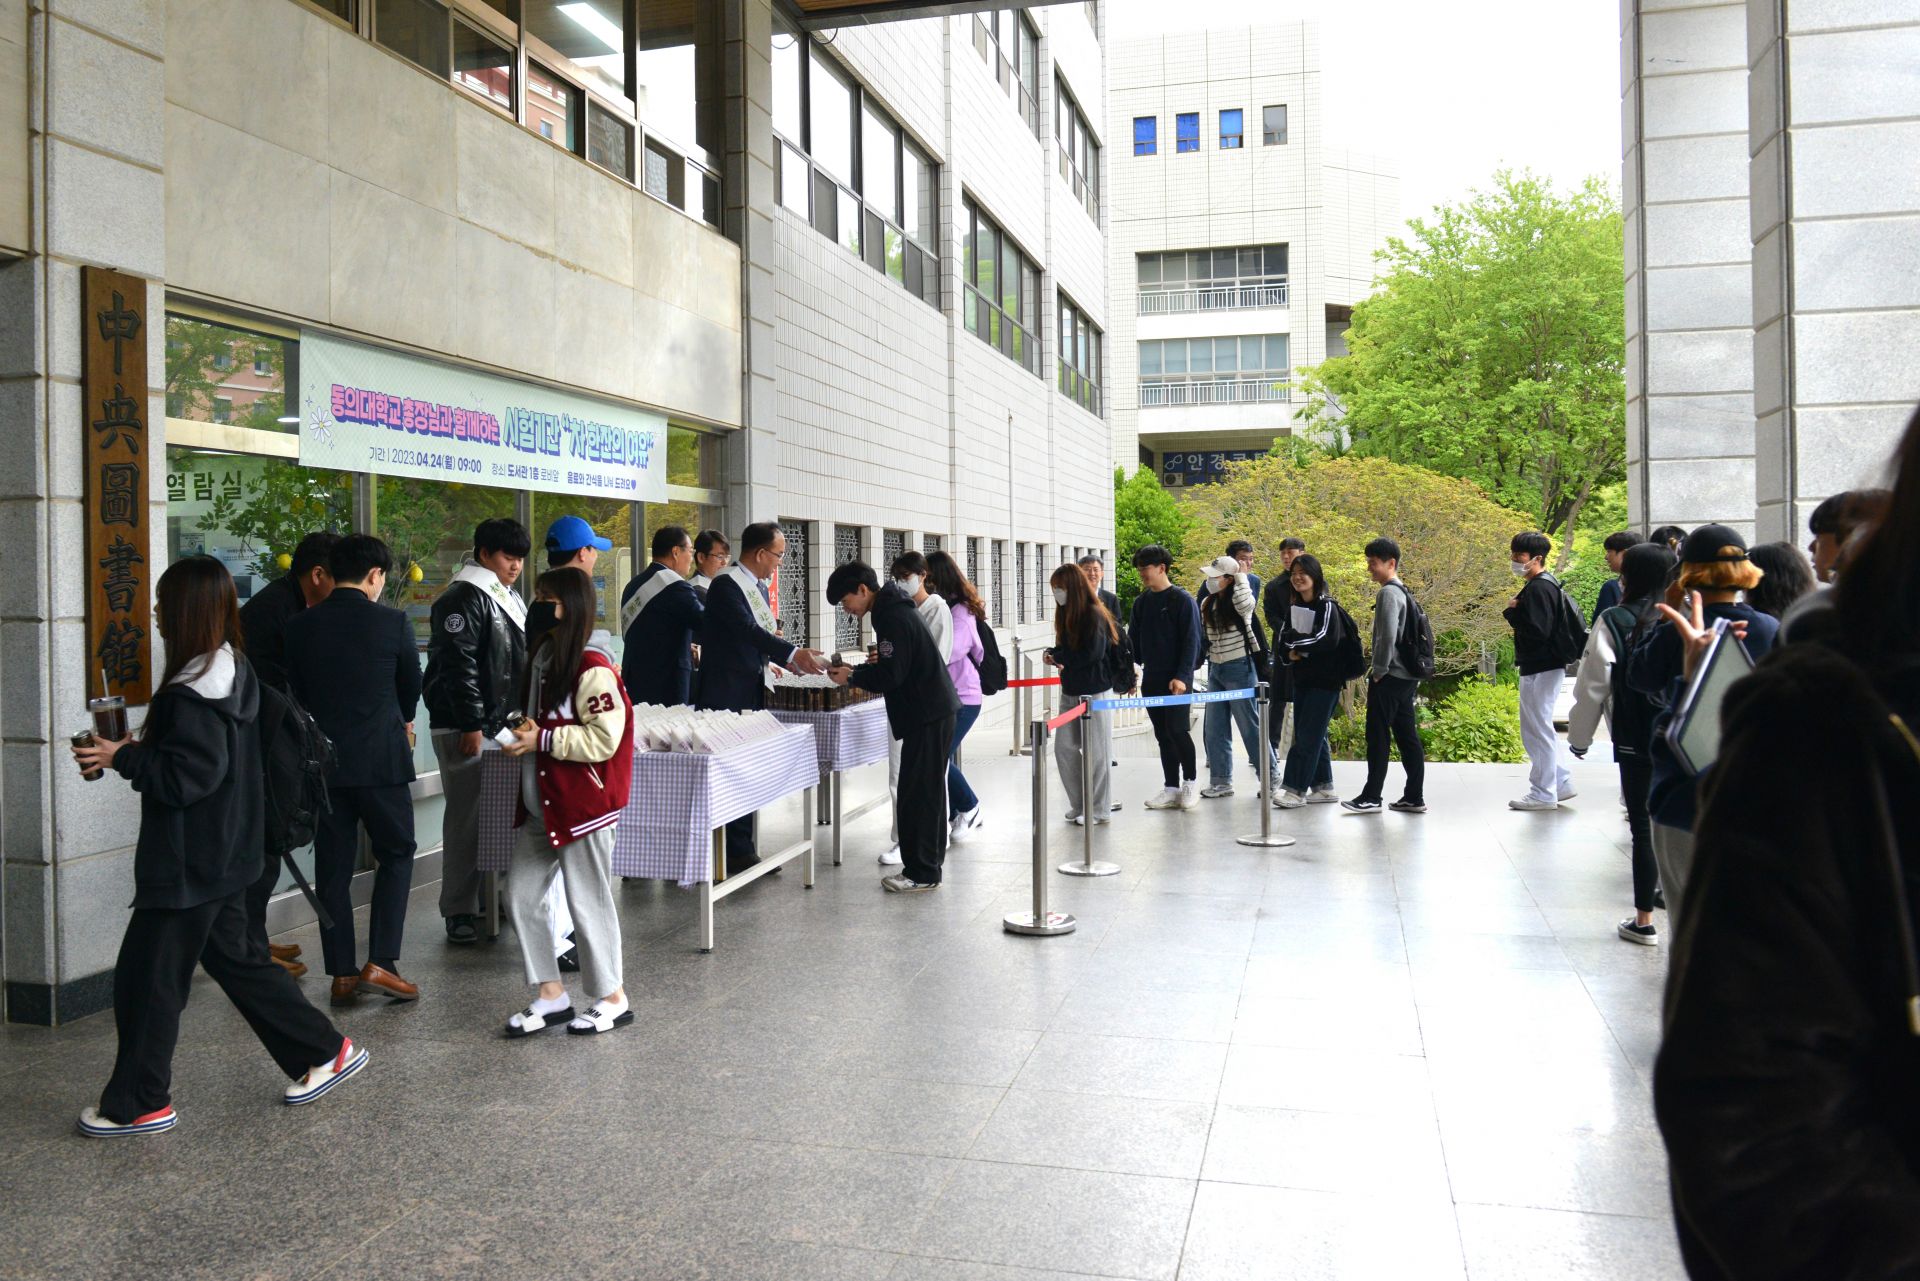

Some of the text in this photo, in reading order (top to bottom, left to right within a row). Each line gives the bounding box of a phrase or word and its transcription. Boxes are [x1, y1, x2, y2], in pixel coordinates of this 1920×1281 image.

[331, 384, 403, 430] 동의대학교
[403, 397, 453, 439] 총장님과
[454, 406, 500, 446] 함께하는
[503, 407, 561, 456] 시험기간
[369, 447, 385, 461] 기간
[457, 457, 482, 473] 09:00
[507, 464, 528, 479] 도서관
[529, 466, 540, 480] 1층
[567, 471, 585, 485] 음료와
[586, 473, 602, 487] 간식을
[166, 470, 242, 502] 열람실
[587, 692, 615, 714] 23
